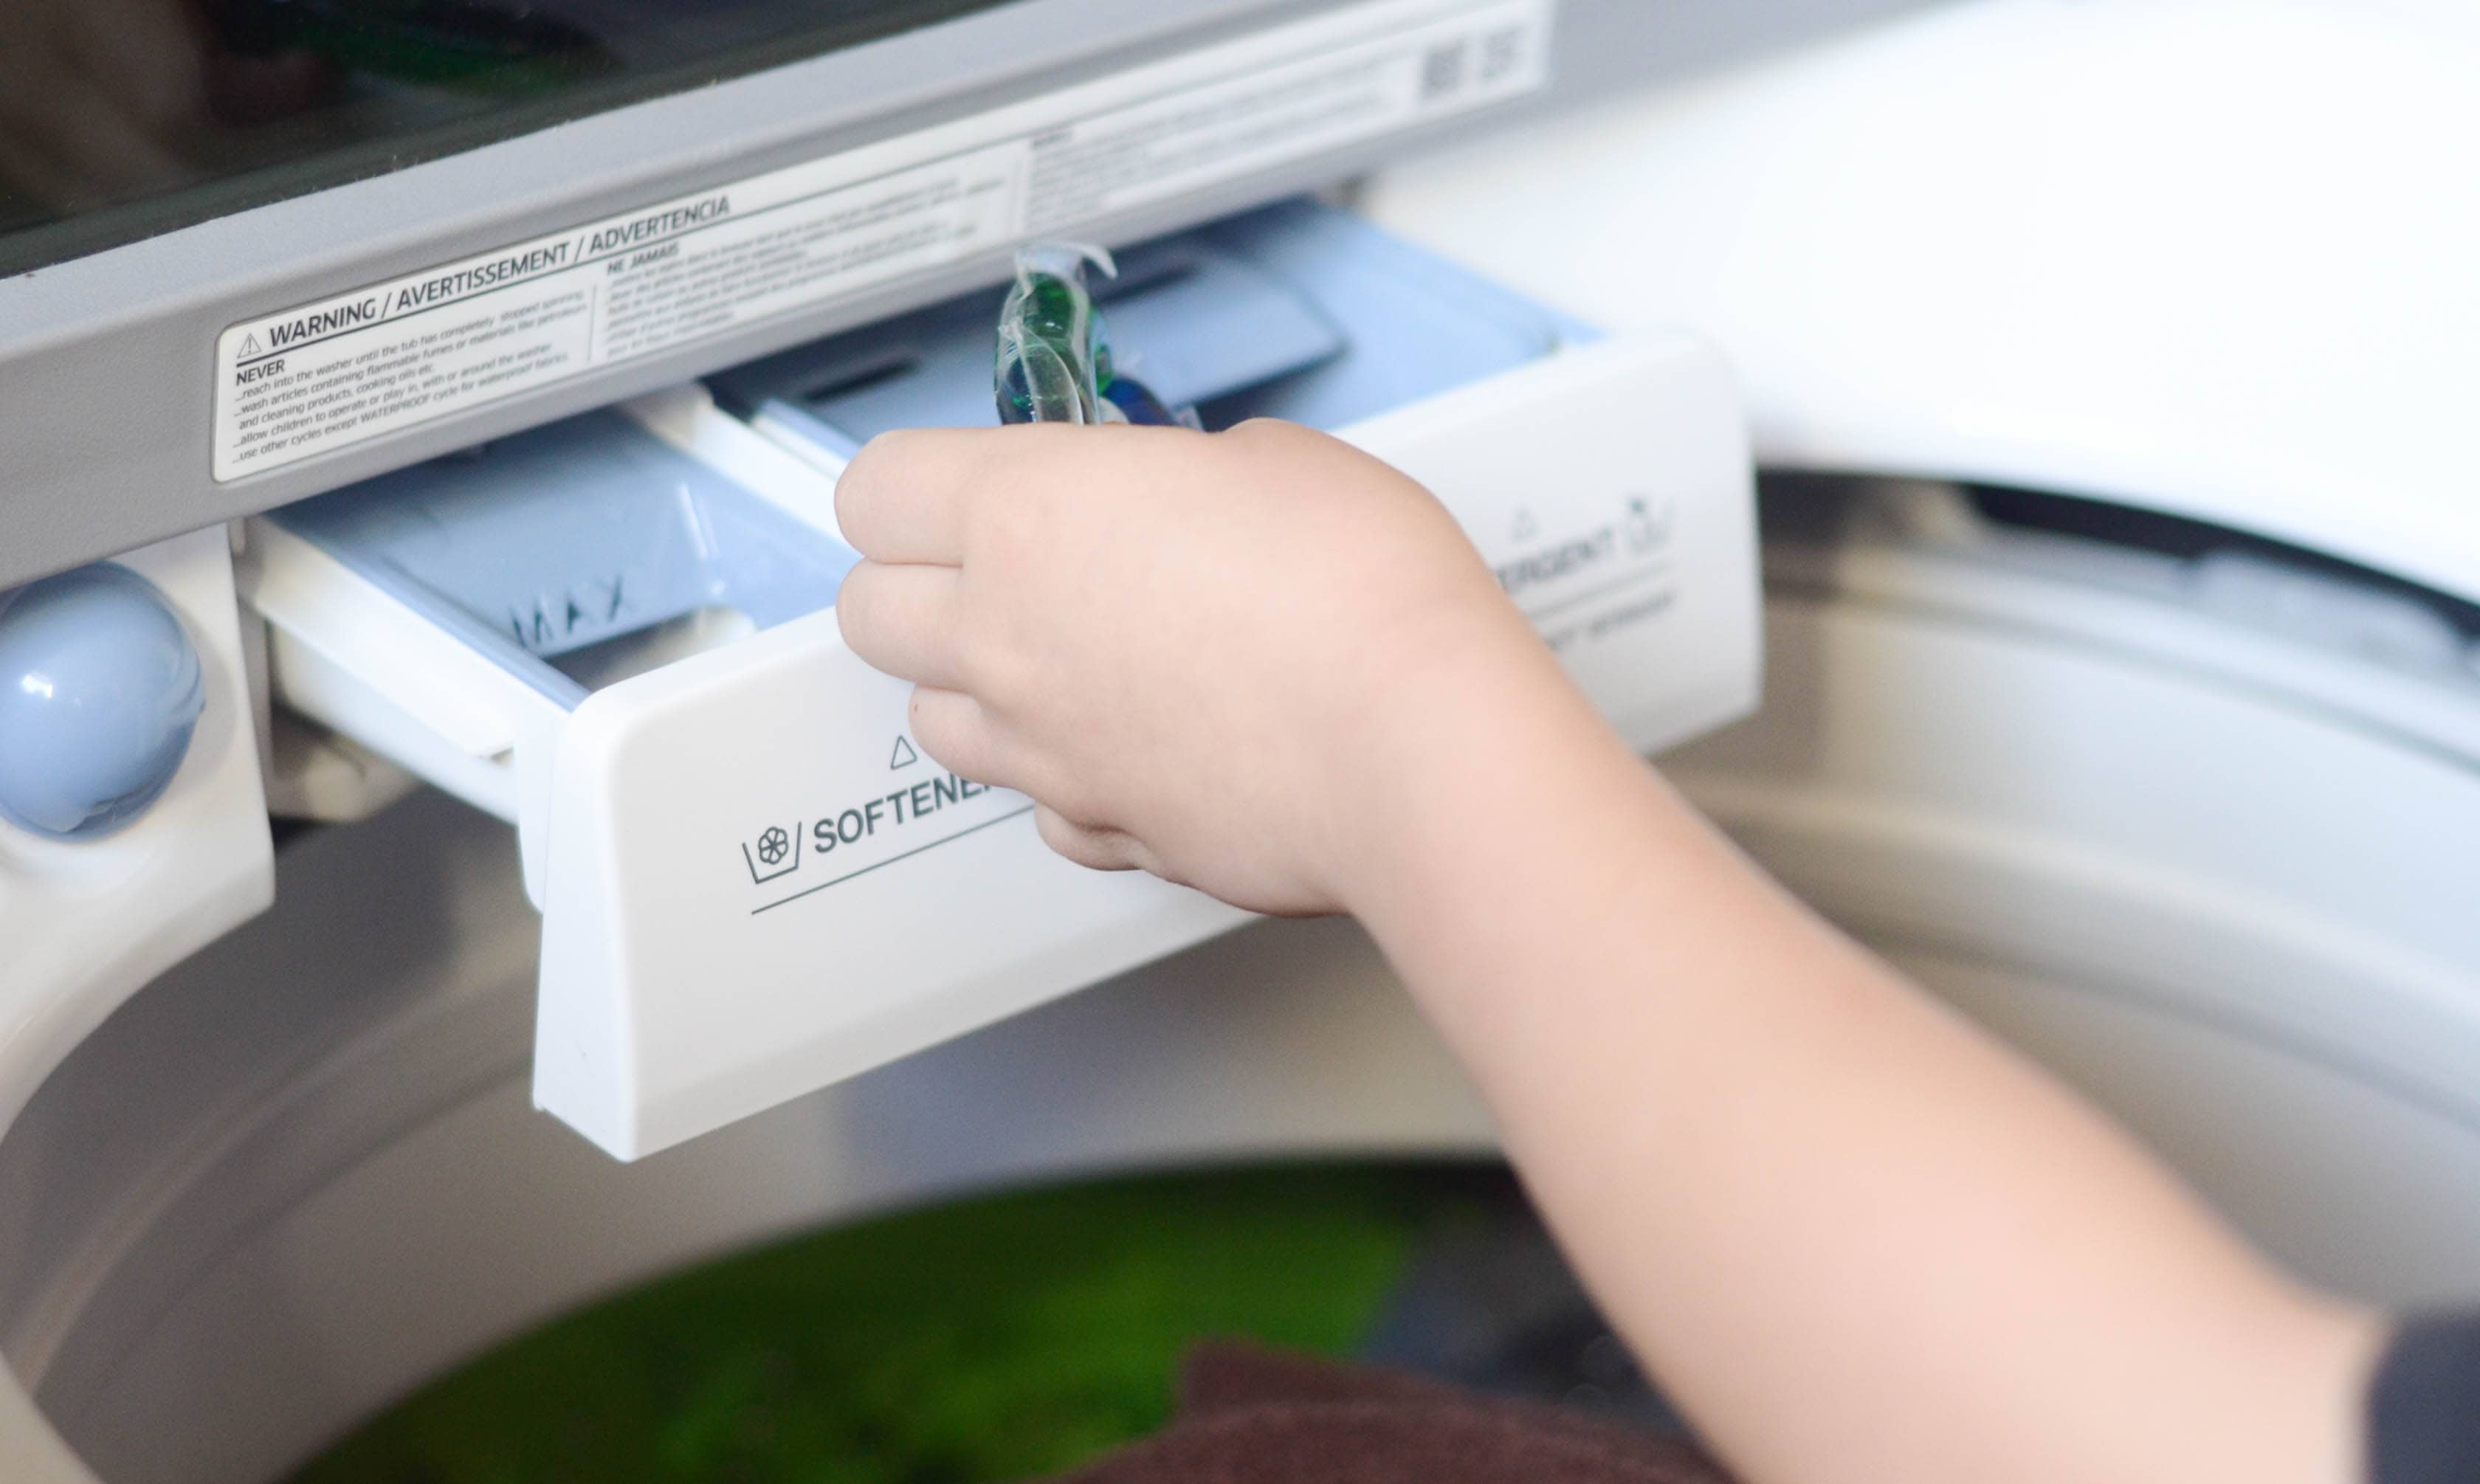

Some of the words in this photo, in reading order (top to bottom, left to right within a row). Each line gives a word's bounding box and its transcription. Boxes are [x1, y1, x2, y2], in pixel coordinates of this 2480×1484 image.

[269, 298, 376, 348] WARNING
[380, 291, 393, 320] /
[396, 241, 570, 311] AVERTISSEMENT
[573, 235, 585, 263] /
[589, 196, 729, 255] ADVERTENCIA
[235, 359, 285, 386] NEVER
[271, 387, 308, 405] articles
[311, 370, 364, 394] containing
[367, 353, 421, 376] flammable
[423, 344, 454, 359] fumes
[455, 339, 465, 350] or
[274, 376, 294, 390] into
[296, 370, 314, 382] the
[316, 359, 352, 377] washer
[355, 349, 379, 365] until
[382, 345, 399, 357] the
[401, 338, 418, 352] tub
[420, 333, 438, 345] has
[439, 317, 495, 340] completely
[239, 415, 258, 430] and
[261, 403, 305, 424] cleaning
[356, 375, 396, 394] cooking
[399, 369, 416, 382] oils
[260, 438, 287, 455] other
[291, 428, 322, 446] cycles
[324, 416, 358, 435] except
[360, 393, 430, 423] WATERPROOF
[433, 386, 458, 401] cycle
[271, 415, 313, 436] children
[315, 413, 326, 422] to
[328, 399, 367, 418] operate
[369, 395, 379, 406] or
[383, 389, 404, 404] play
[422, 375, 445, 390] with
[447, 372, 457, 382] or
[813, 773, 991, 854] SOFTENE
